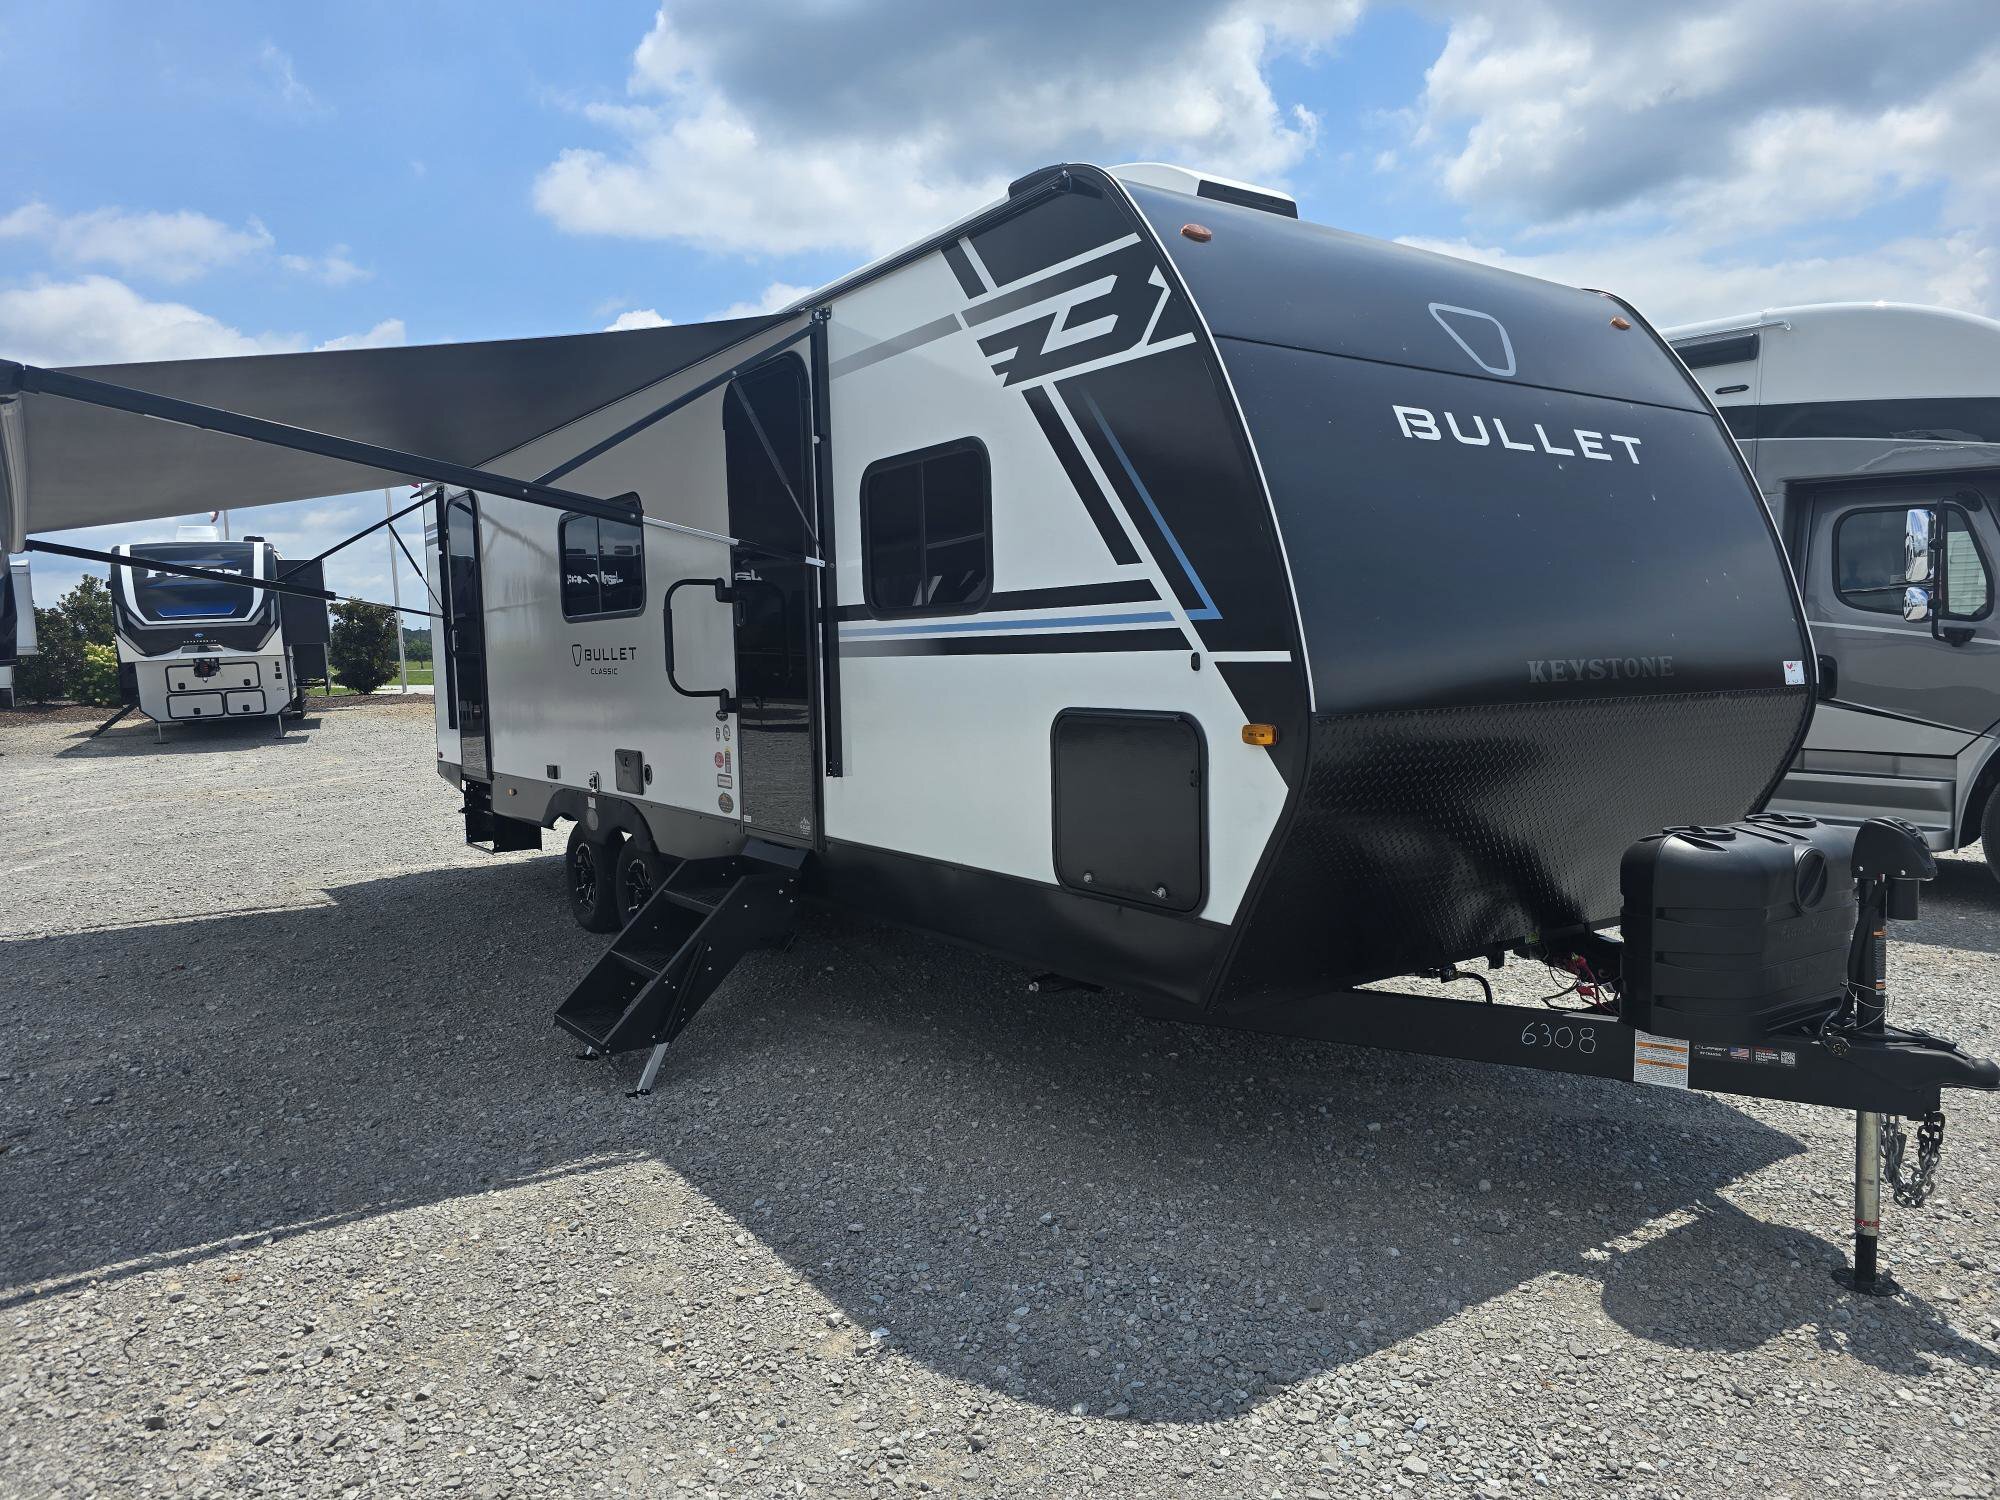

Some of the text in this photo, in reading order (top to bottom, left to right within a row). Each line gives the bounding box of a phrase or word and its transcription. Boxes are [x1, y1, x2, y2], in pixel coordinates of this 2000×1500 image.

[1391, 404, 1642, 465] BULLET
[584, 646, 637, 661] BULLET
[590, 667, 619, 675] CLASSIC
[1527, 655, 1675, 683] KEYSTONE
[1521, 1021, 1597, 1054] 6308
